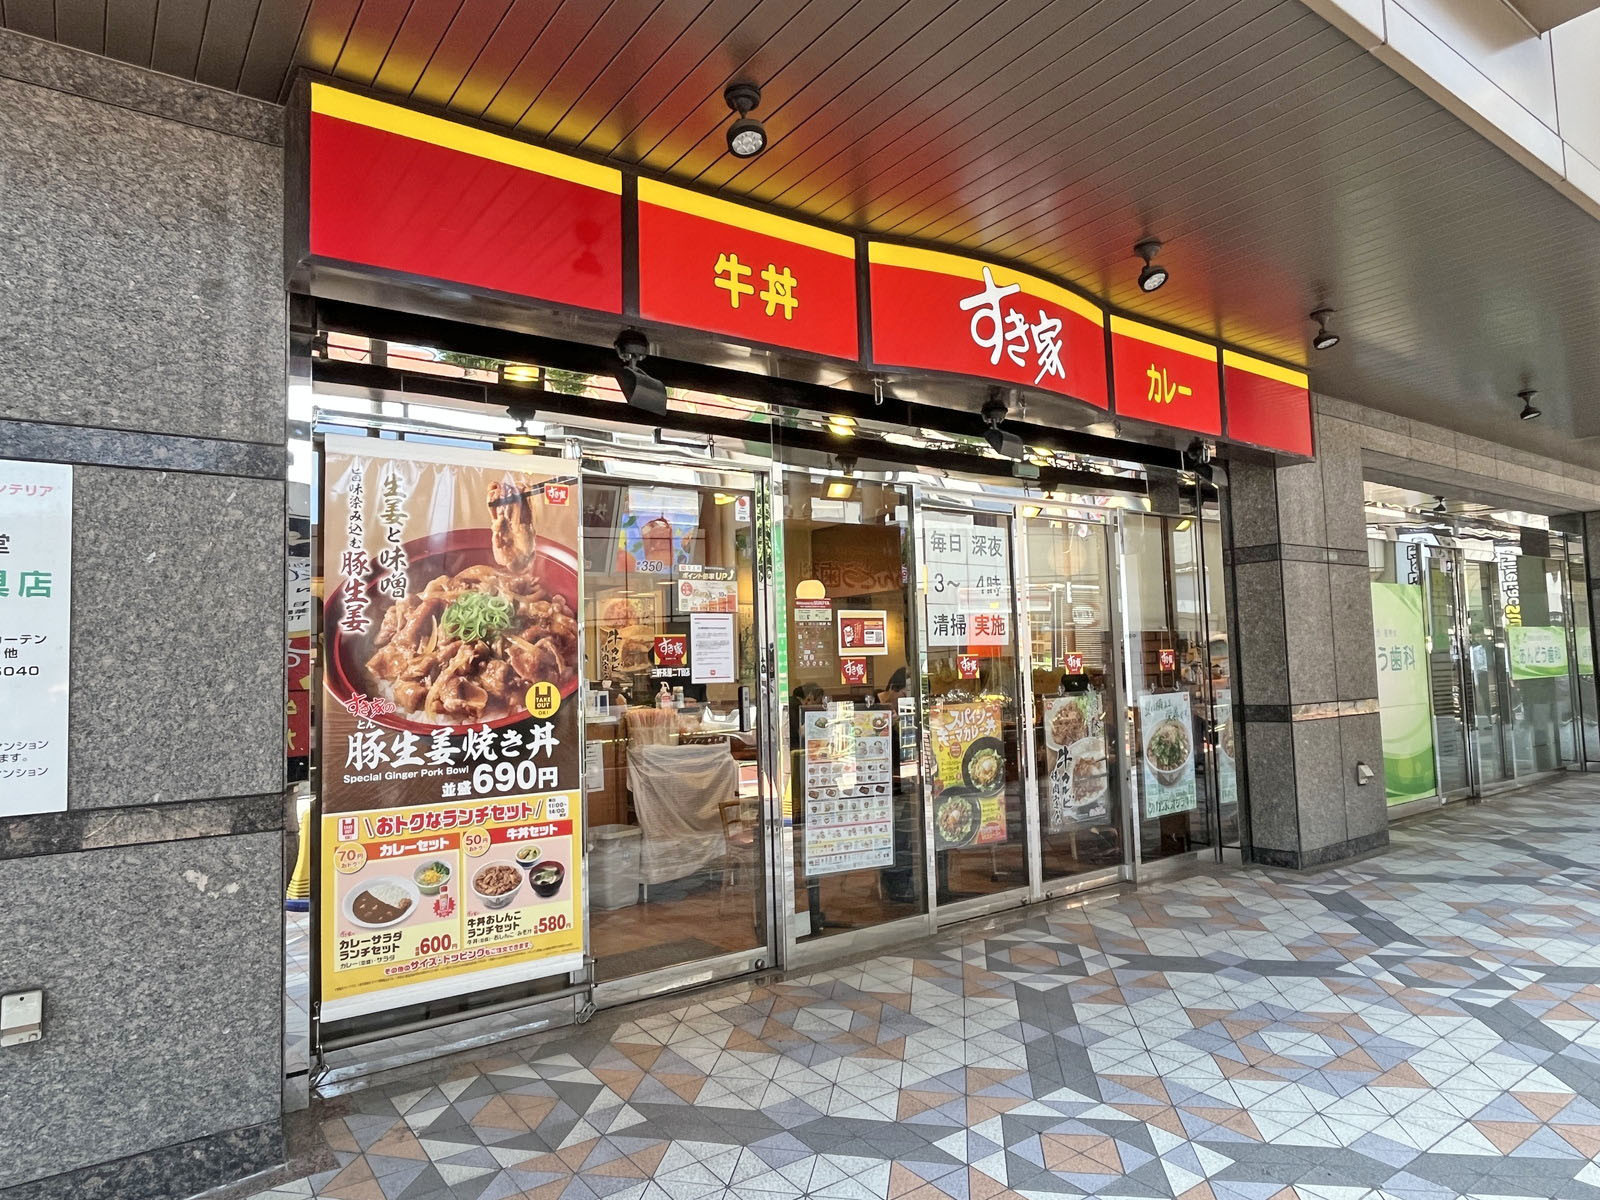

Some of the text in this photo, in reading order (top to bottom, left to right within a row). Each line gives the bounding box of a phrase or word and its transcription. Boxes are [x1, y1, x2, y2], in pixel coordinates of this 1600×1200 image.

[713, 253, 799, 320] 牛丼
[959, 266, 1067, 385] すき家
[1146, 363, 1193, 405] カレー
[380, 473, 408, 599] 生姜と味噌
[930, 530, 1003, 557] 毎日 深夜
[341, 468, 370, 633] 旨味染み込む豚生姜
[933, 614, 1006, 637] 清掃 実施
[0, 634, 47, 645] ーテン
[658, 637, 684, 657] すき家
[4, 648, 18, 659] 他
[1377, 645, 1416, 671] う歯科
[0, 665, 39, 676] 040
[843, 659, 865, 677] すき家
[344, 692, 397, 718] すき家の
[357, 720, 376, 730] とん
[0, 740, 49, 752] ンション
[344, 721, 560, 772] 豚生姜焼き丼
[0, 767, 48, 779] ンション
[343, 765, 469, 784] Special Ginger Pork Bowl
[376, 802, 532, 836] おトクなランチセット
[465, 835, 488, 846] 50円
[506, 824, 558, 840] 牛丼セット
[337, 850, 363, 862] 70円
[379, 837, 450, 857] カレーセット
[467, 911, 521, 928] 牛丼おしんこ
[538, 914, 572, 934] 580円
[467, 922, 520, 938] ランチセット
[339, 931, 403, 950] カレーサラダ
[420, 934, 458, 955] 600円
[339, 943, 400, 961] ランチセット
